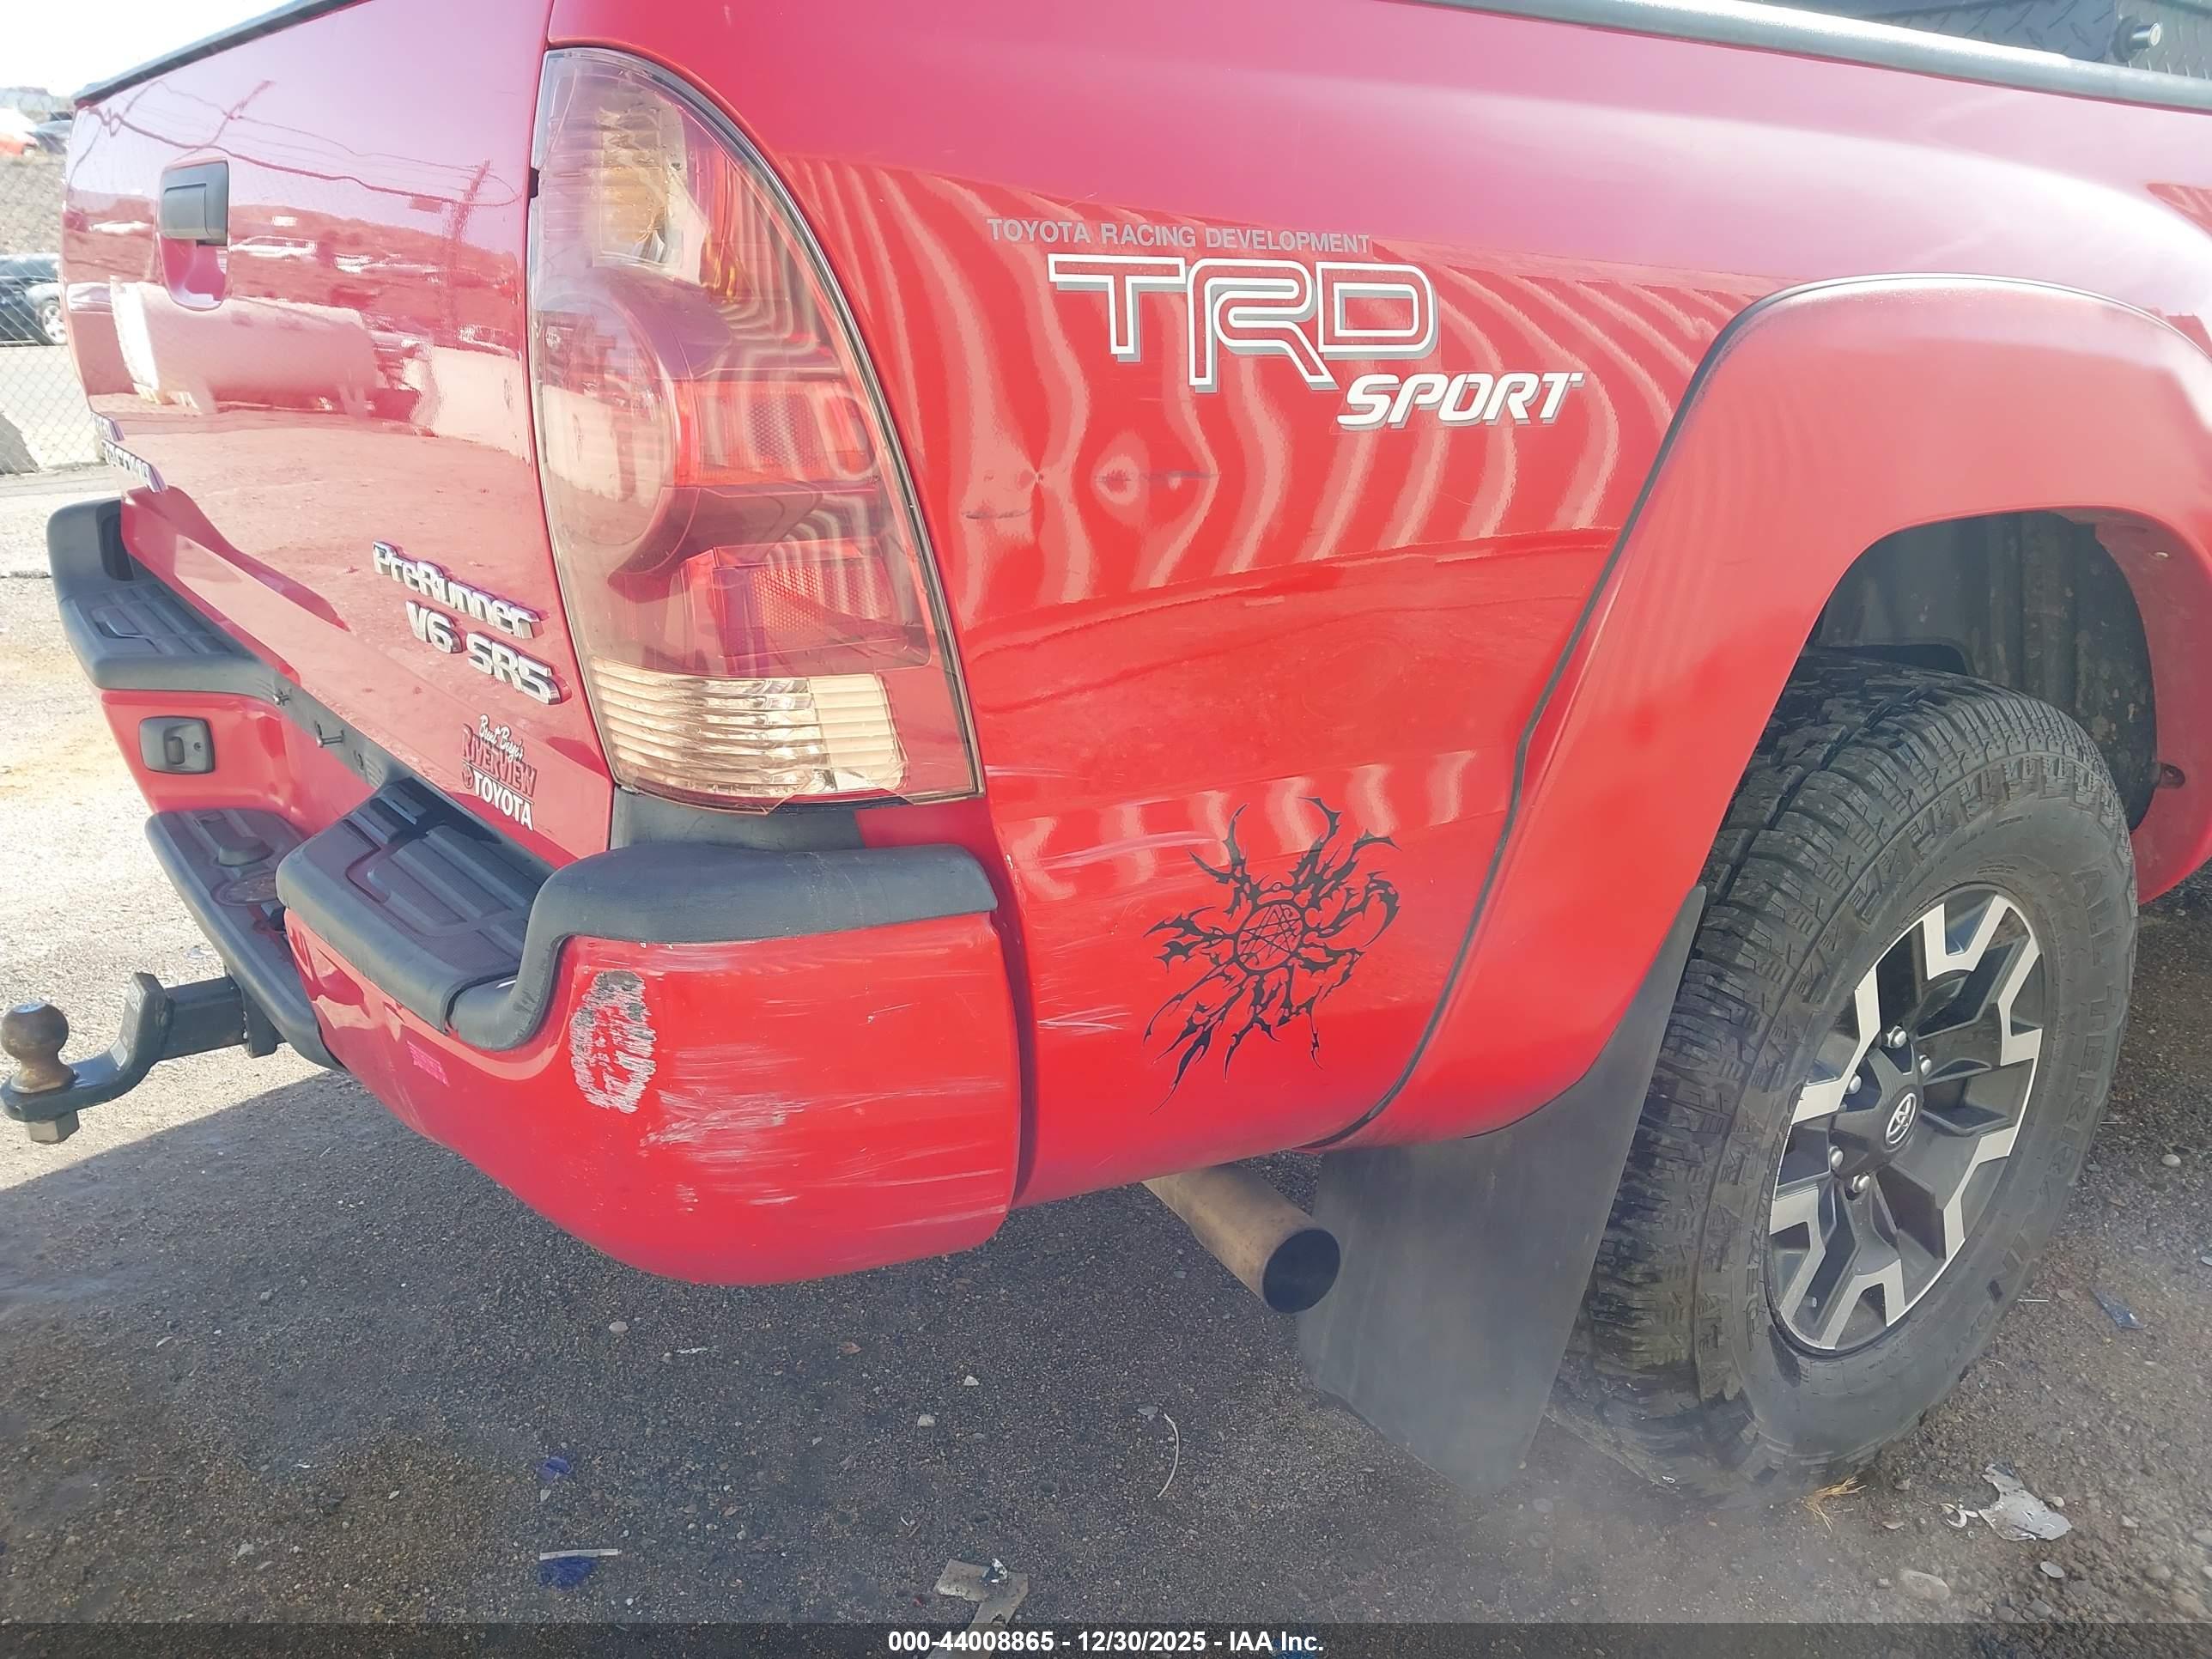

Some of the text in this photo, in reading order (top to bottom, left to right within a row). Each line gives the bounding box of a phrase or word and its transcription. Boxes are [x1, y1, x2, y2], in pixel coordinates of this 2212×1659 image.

[987, 218, 1370, 254] TOYOTA RACING DEVELOPMENT
[1048, 253, 1437, 392] TRD
[1336, 372, 1586, 428] SPORT
[372, 540, 544, 640] PreRunner
[404, 599, 563, 705] V6 SR5
[462, 723, 538, 798] RIVERVIEW
[473, 769, 535, 832] TOYOTA
